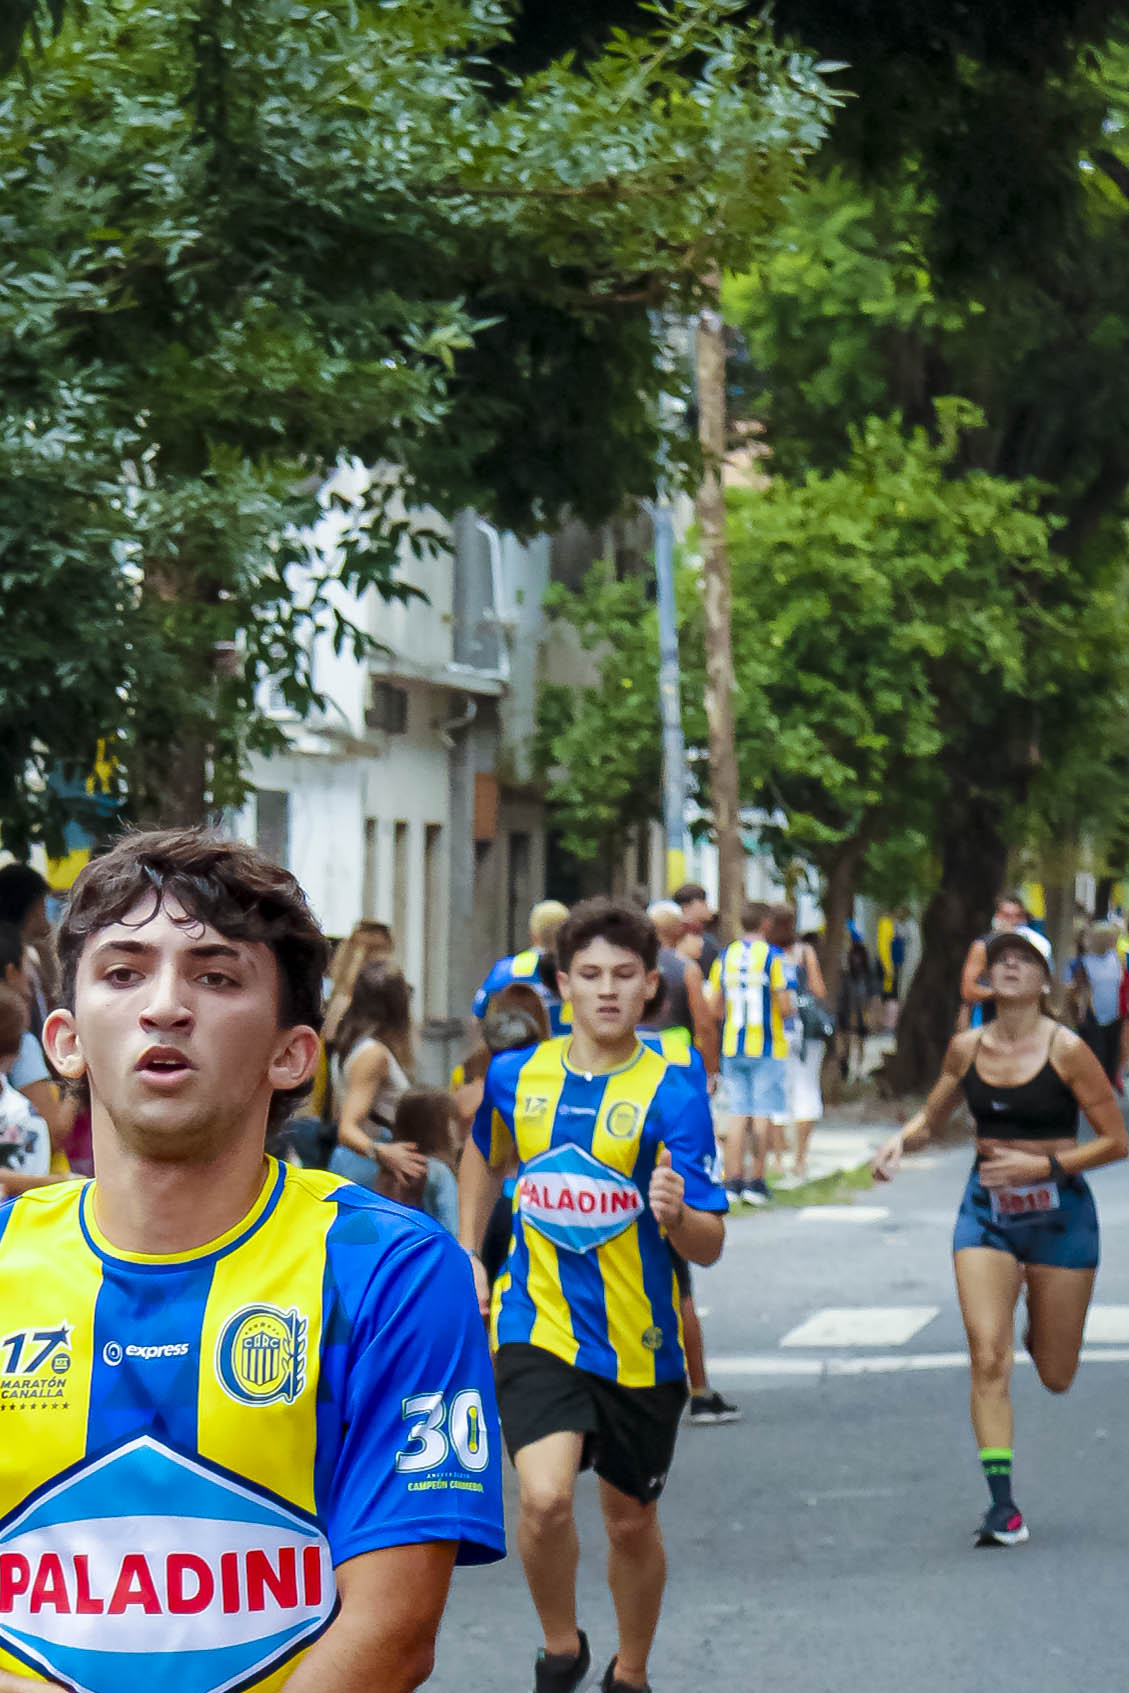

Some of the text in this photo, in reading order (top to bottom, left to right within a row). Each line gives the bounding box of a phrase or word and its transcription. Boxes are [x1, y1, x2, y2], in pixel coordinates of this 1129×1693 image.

[1, 1325, 72, 1374] 17
[125, 1343, 190, 1359] express
[0, 1376, 67, 1389] MARATÓN
[1, 1389, 64, 1400] CANALLA
[395, 1388, 489, 1474] 30
